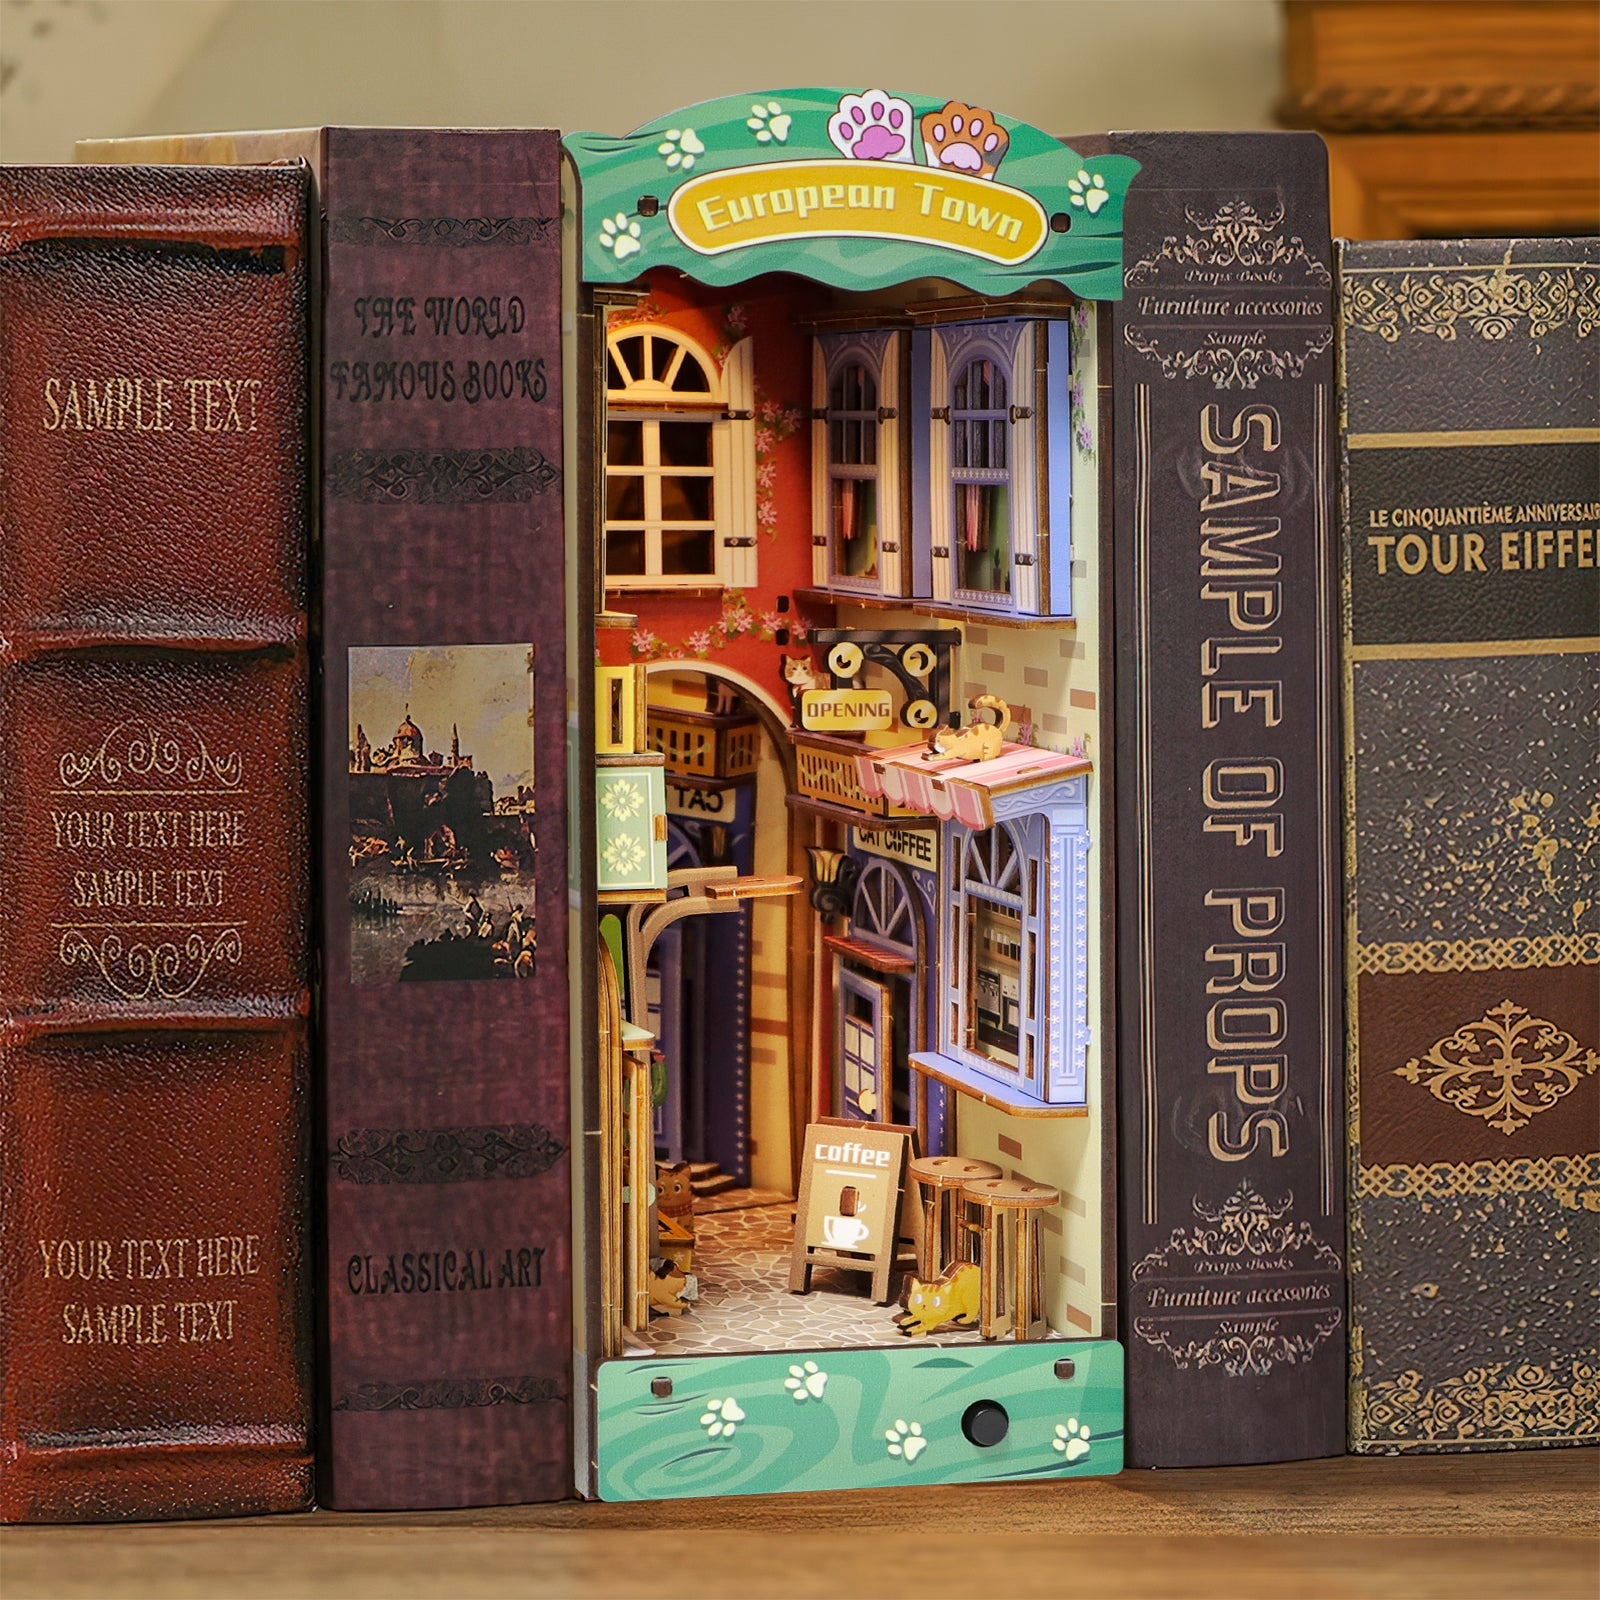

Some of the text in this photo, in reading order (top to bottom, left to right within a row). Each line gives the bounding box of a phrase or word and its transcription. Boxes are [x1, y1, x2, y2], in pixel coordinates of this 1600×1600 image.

[696, 182, 1023, 242] European Town
[354, 295, 525, 339] THE WORLD
[1234, 295, 1324, 316] accessories
[330, 358, 547, 404] FAMOUS BOOKS
[43, 377, 262, 432] SAMPLE TEXT
[1369, 509, 1389, 528] LE
[1391, 501, 1514, 531] CINQUANTIÈME
[1367, 532, 1488, 575] TOUR
[807, 702, 890, 719] OPENING
[1200, 403, 1289, 1162] SAMPLE OF PROPS
[50, 810, 248, 848] YOUR TEXT HERE
[884, 830, 931, 862] COFFEE
[73, 870, 225, 907] SAMPLE TEXT
[815, 1142, 890, 1167] coffee
[39, 1234, 260, 1280] YOUR TEXT HERE
[348, 1247, 545, 1295] CLASSICAL ART
[62, 1300, 237, 1345] SAMPLE TEXT
